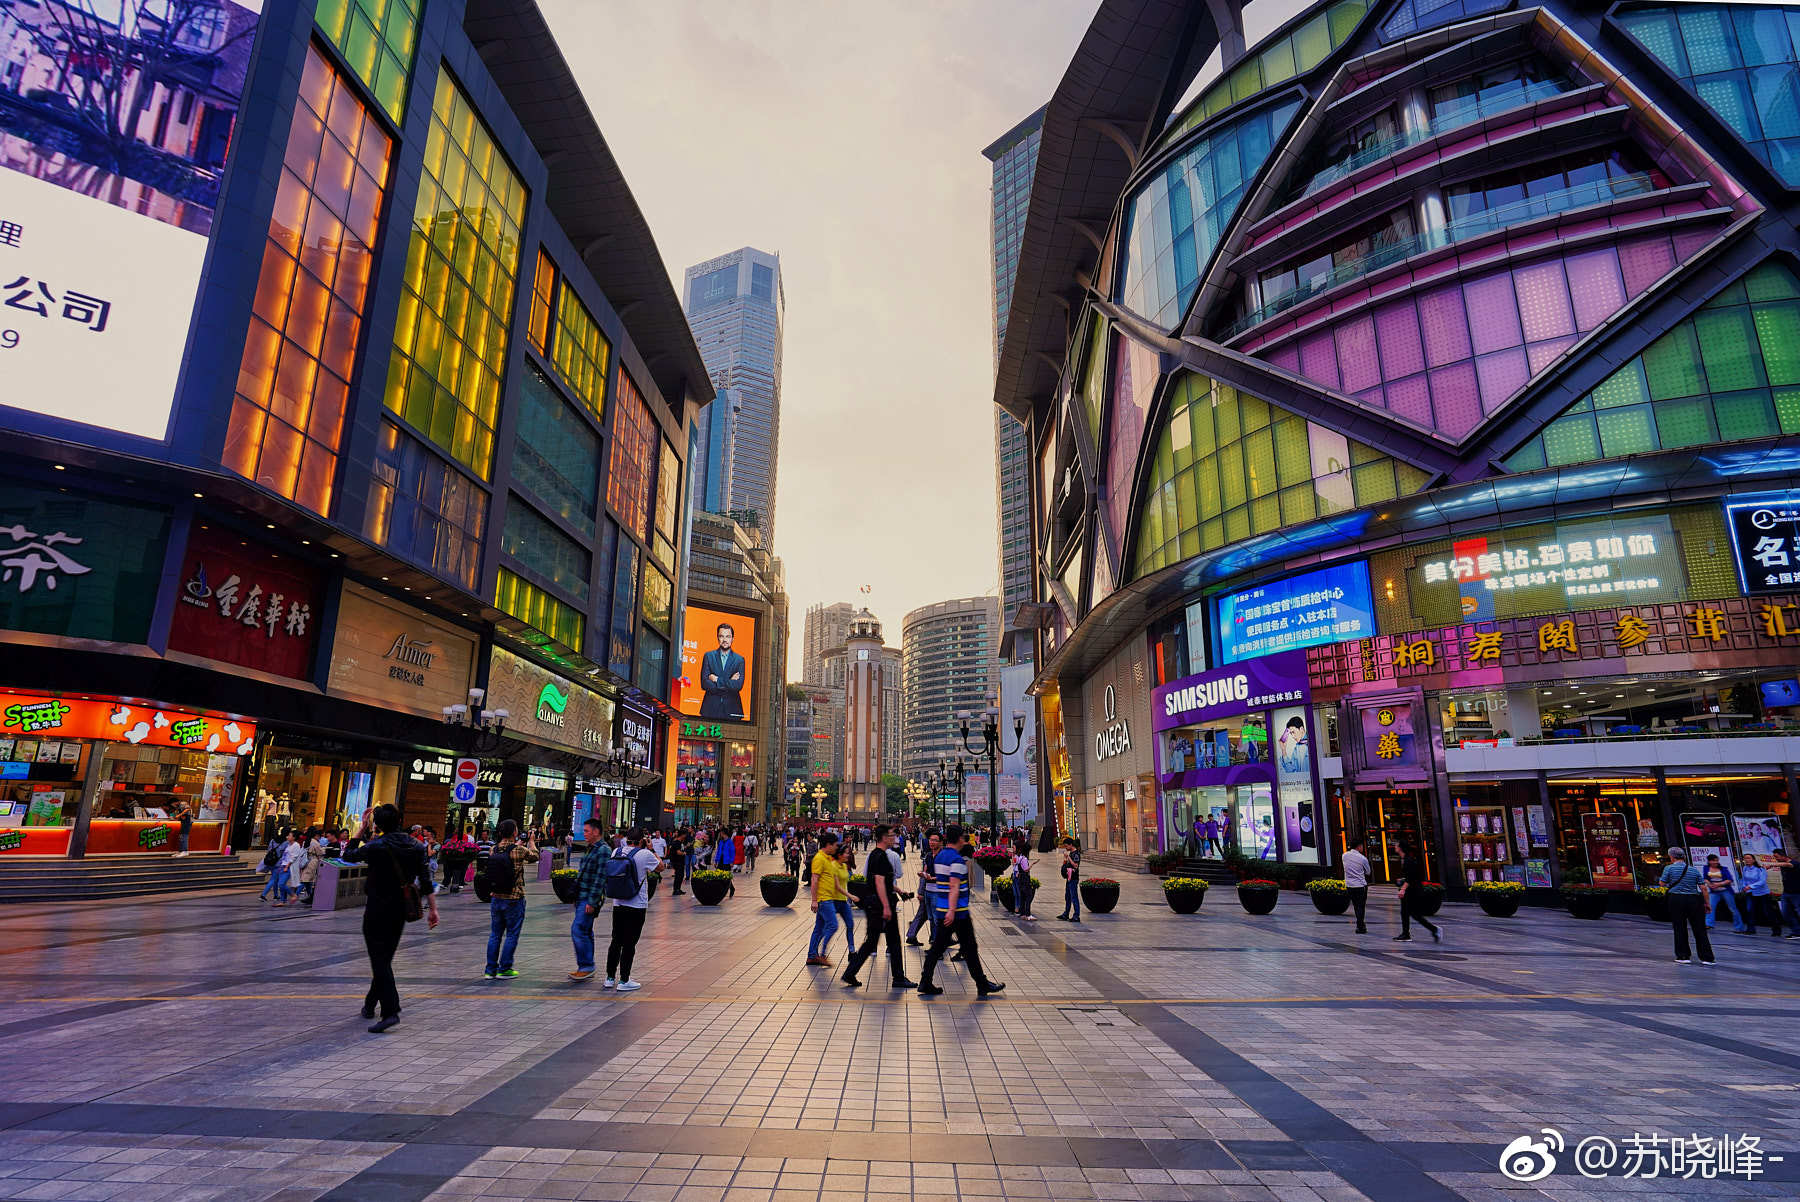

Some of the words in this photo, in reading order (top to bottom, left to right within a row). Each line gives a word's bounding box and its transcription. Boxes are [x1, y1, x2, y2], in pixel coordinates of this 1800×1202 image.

[3, 275, 111, 333] 公司
[1, 329, 20, 349] 9
[0, 524, 93, 592] 茶
[1165, 674, 1249, 716] SAMSUNG
[539, 709, 565, 728] QIANYE
[623, 718, 637, 738] CRD
[1096, 719, 1132, 761] OMEGA
